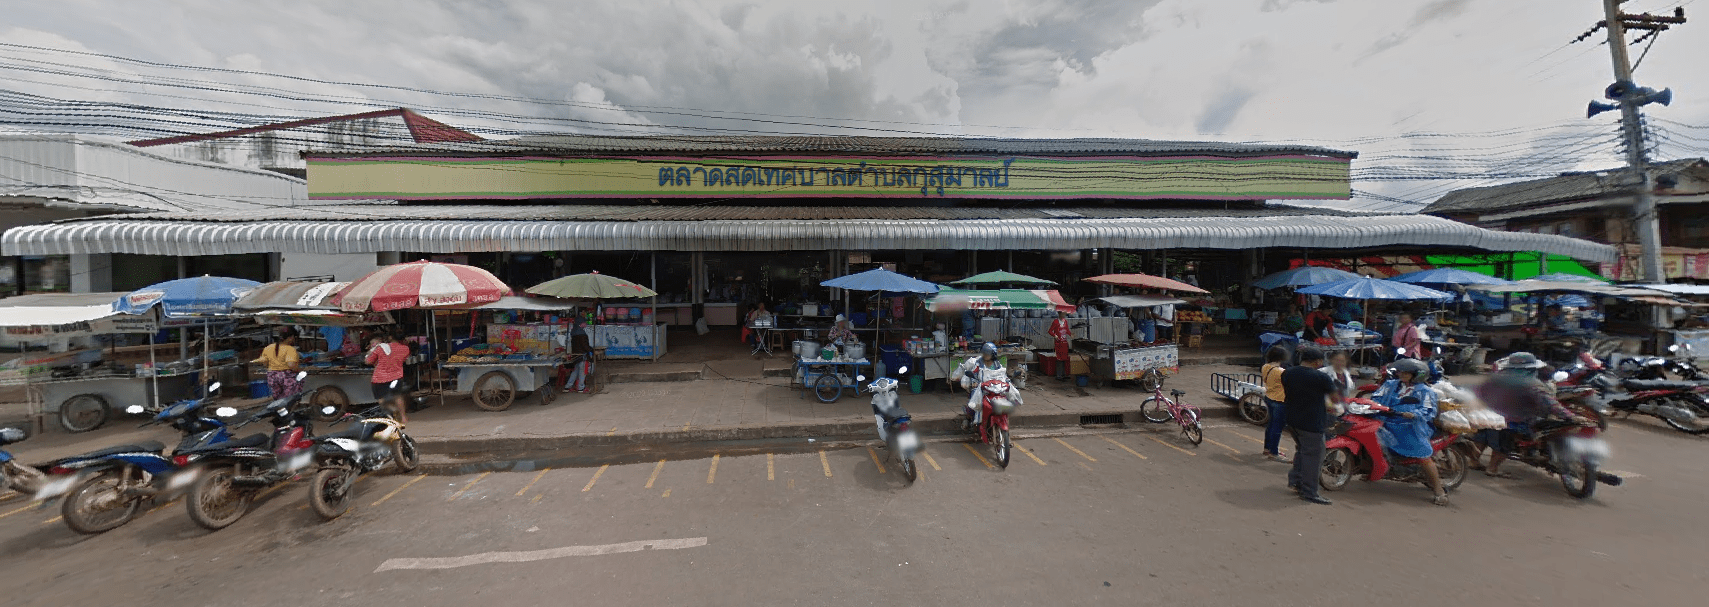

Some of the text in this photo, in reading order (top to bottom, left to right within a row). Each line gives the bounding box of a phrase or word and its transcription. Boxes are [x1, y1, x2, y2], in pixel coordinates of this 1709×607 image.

[658, 157, 1016, 196] ตลาดสดเทศบาลตำบลกุสุมาลย์
